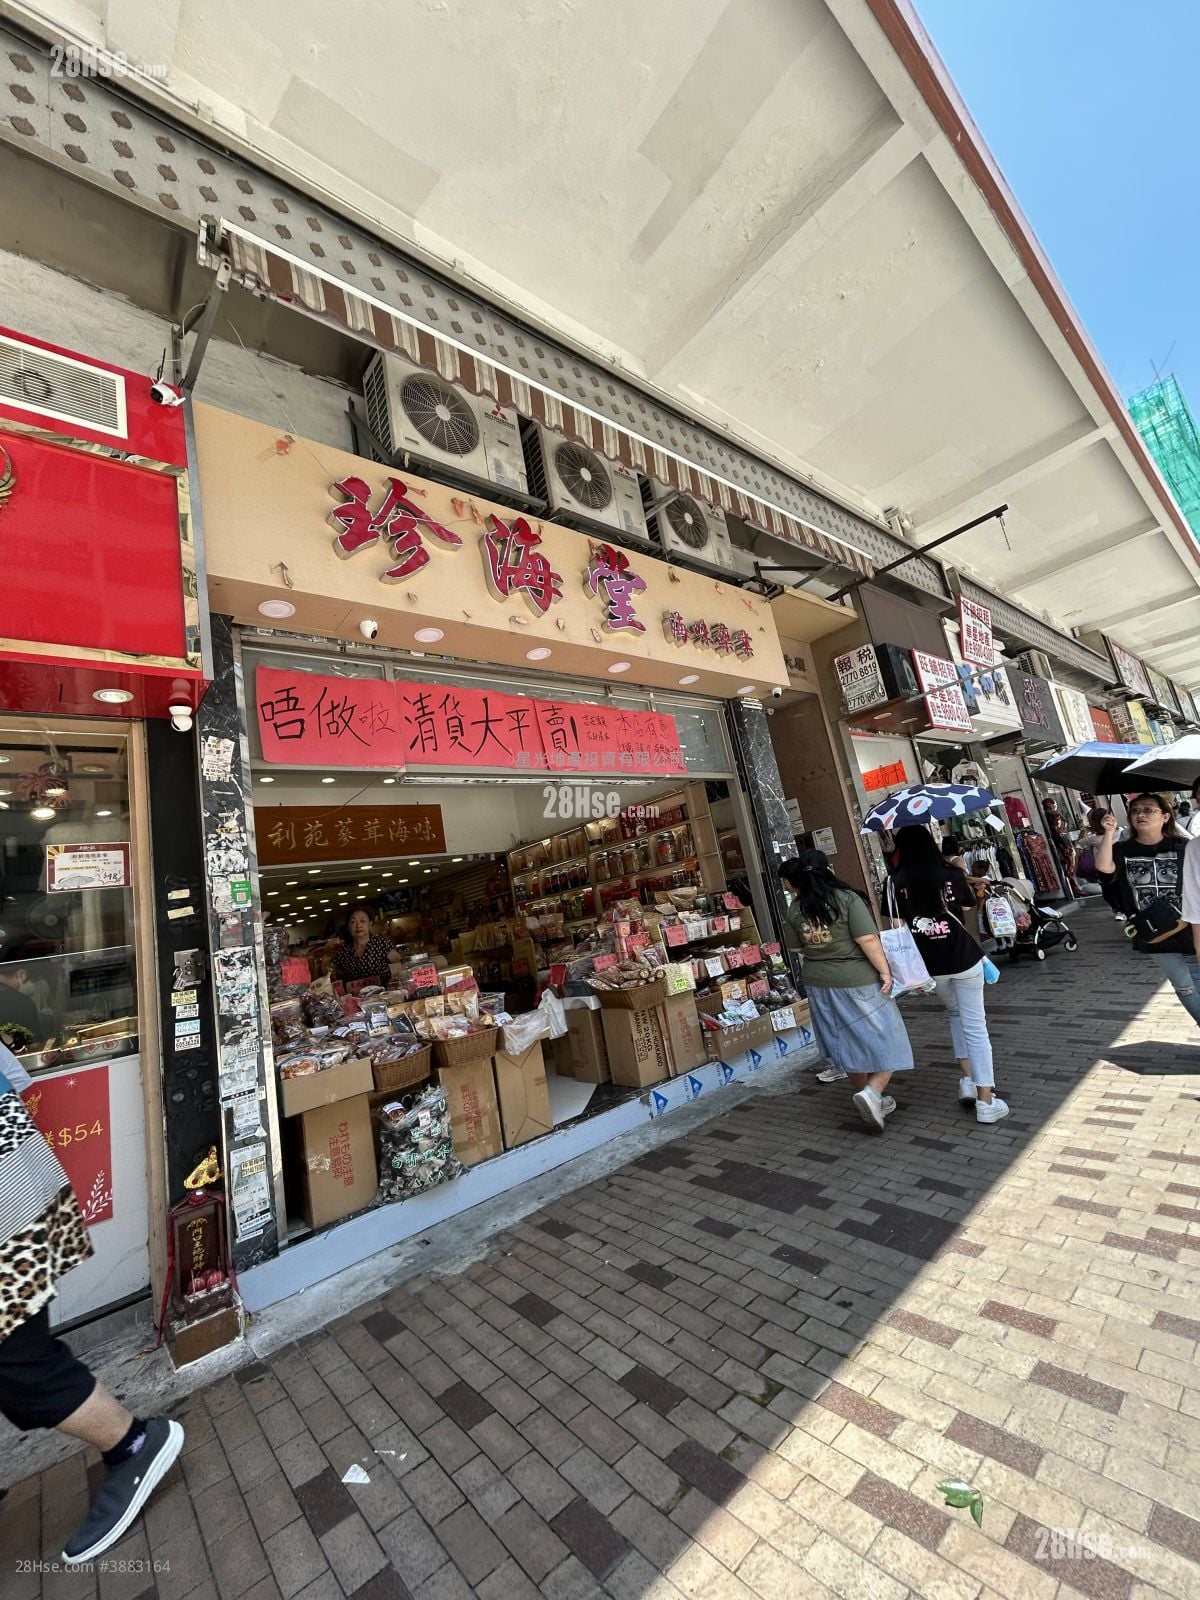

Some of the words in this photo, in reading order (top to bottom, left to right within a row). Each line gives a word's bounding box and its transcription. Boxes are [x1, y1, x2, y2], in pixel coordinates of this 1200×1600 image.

[327, 476, 648, 637] 珍海堂
[837, 646, 874, 674] 報稅
[841, 670, 858, 686] 2770
[859, 662, 877, 677] 8819
[260, 686, 396, 746] 唔做啦
[58, 1119, 104, 1147] $54
